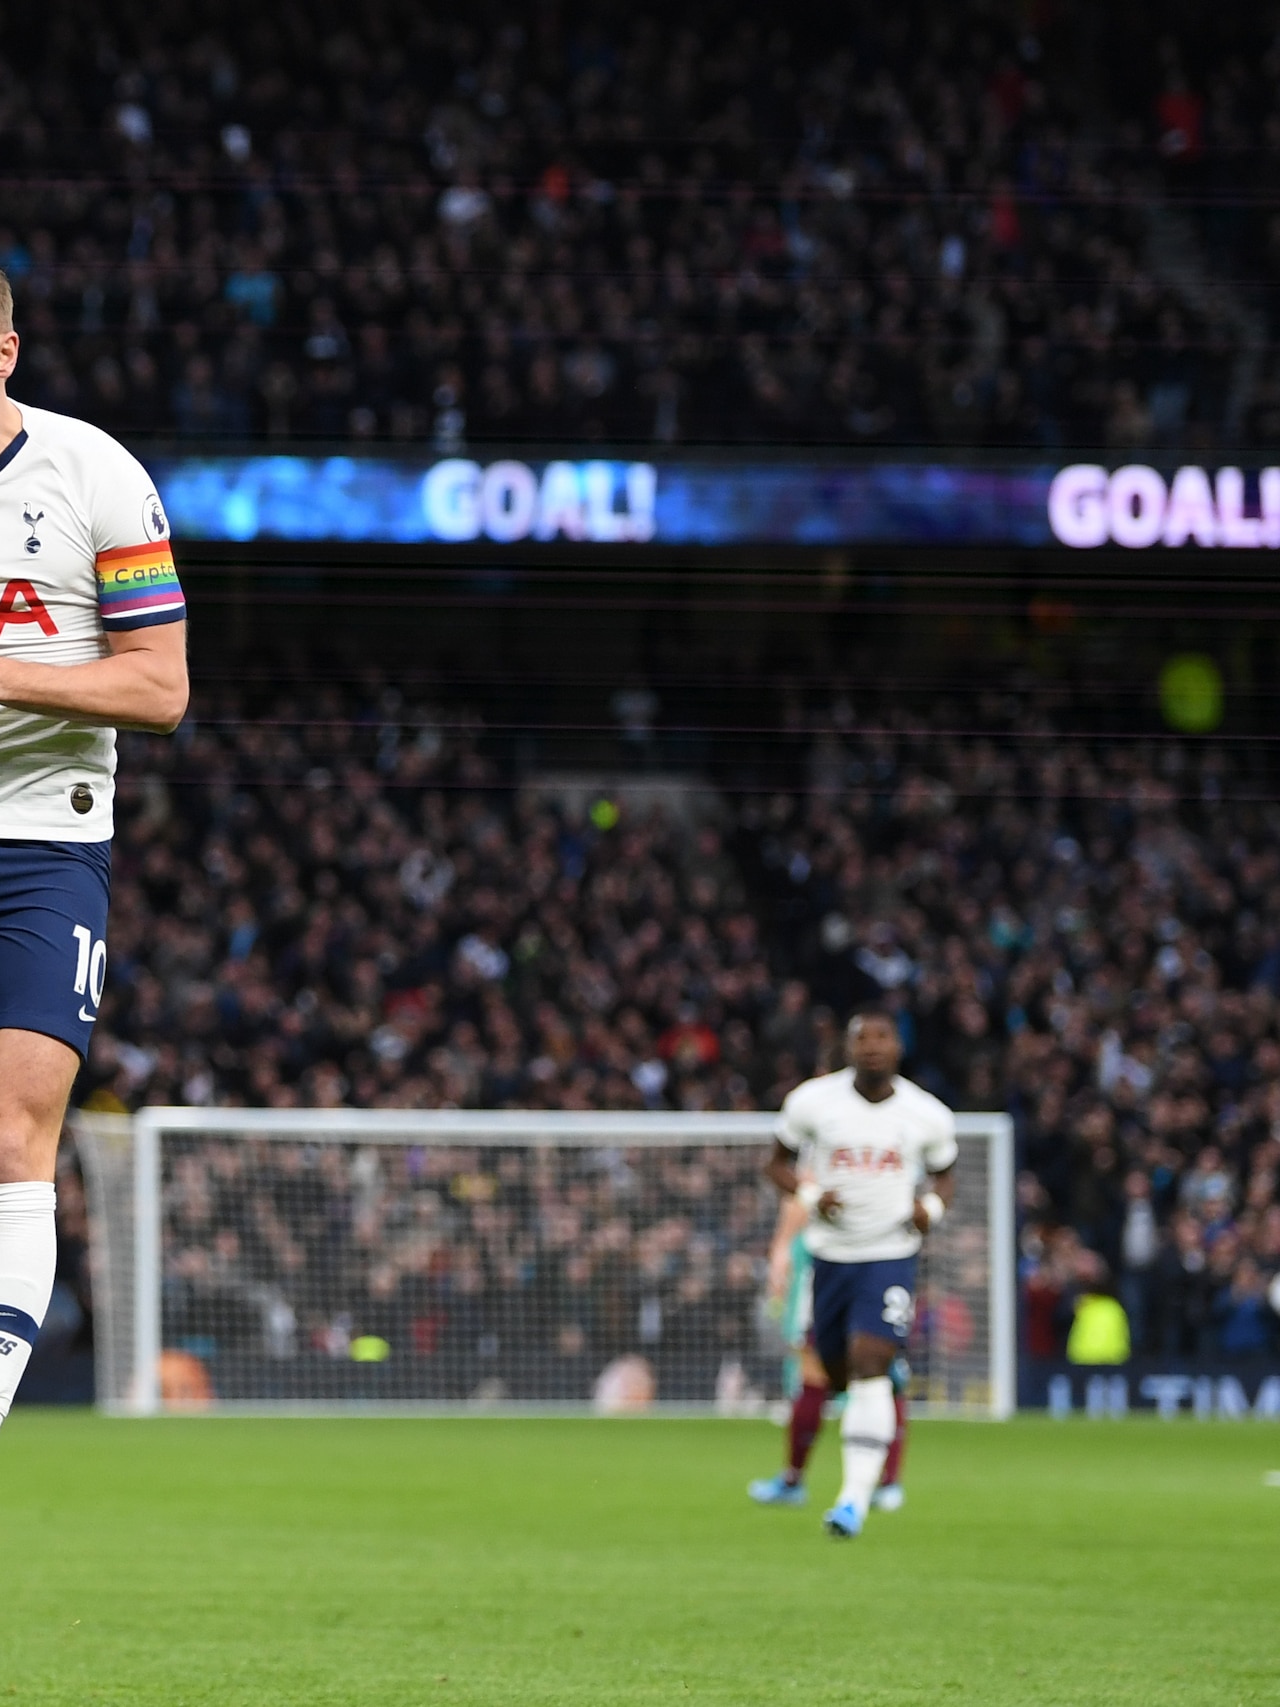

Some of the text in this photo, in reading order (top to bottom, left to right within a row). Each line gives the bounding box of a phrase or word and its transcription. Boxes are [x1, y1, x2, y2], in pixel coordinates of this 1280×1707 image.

[419, 458, 658, 542] GOAL!
[72, 924, 107, 1009] 10
[829, 1146, 904, 1171] AIA
